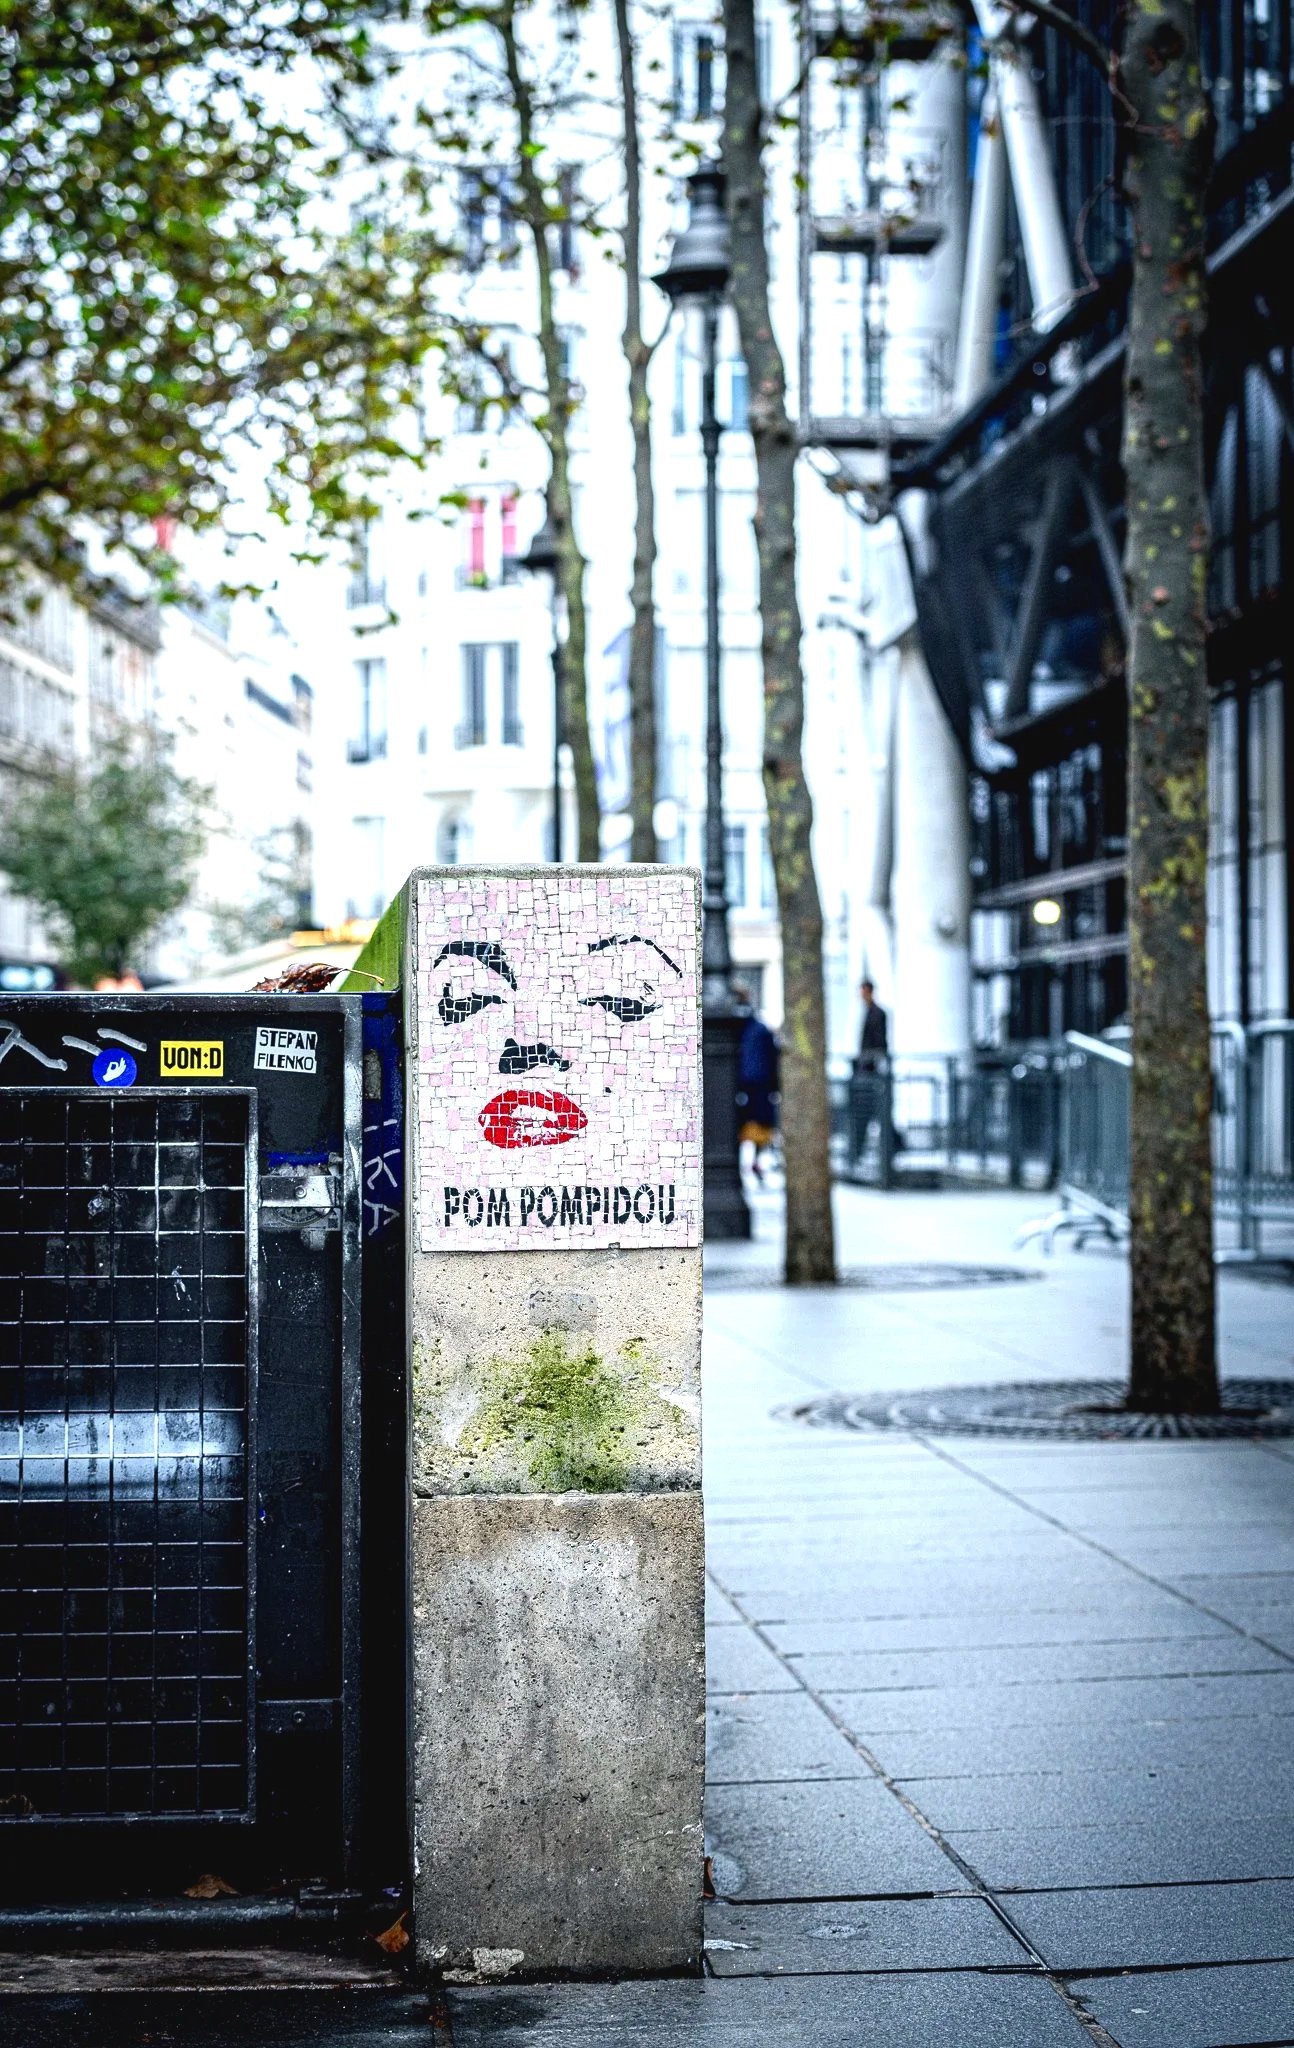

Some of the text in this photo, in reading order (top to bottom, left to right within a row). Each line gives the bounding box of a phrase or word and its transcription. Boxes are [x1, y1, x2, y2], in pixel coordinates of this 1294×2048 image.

[259, 1029, 317, 1050] STEPAN
[257, 1052, 314, 1071] FILENKO
[444, 1183, 676, 1228] POM POMPIDOU
